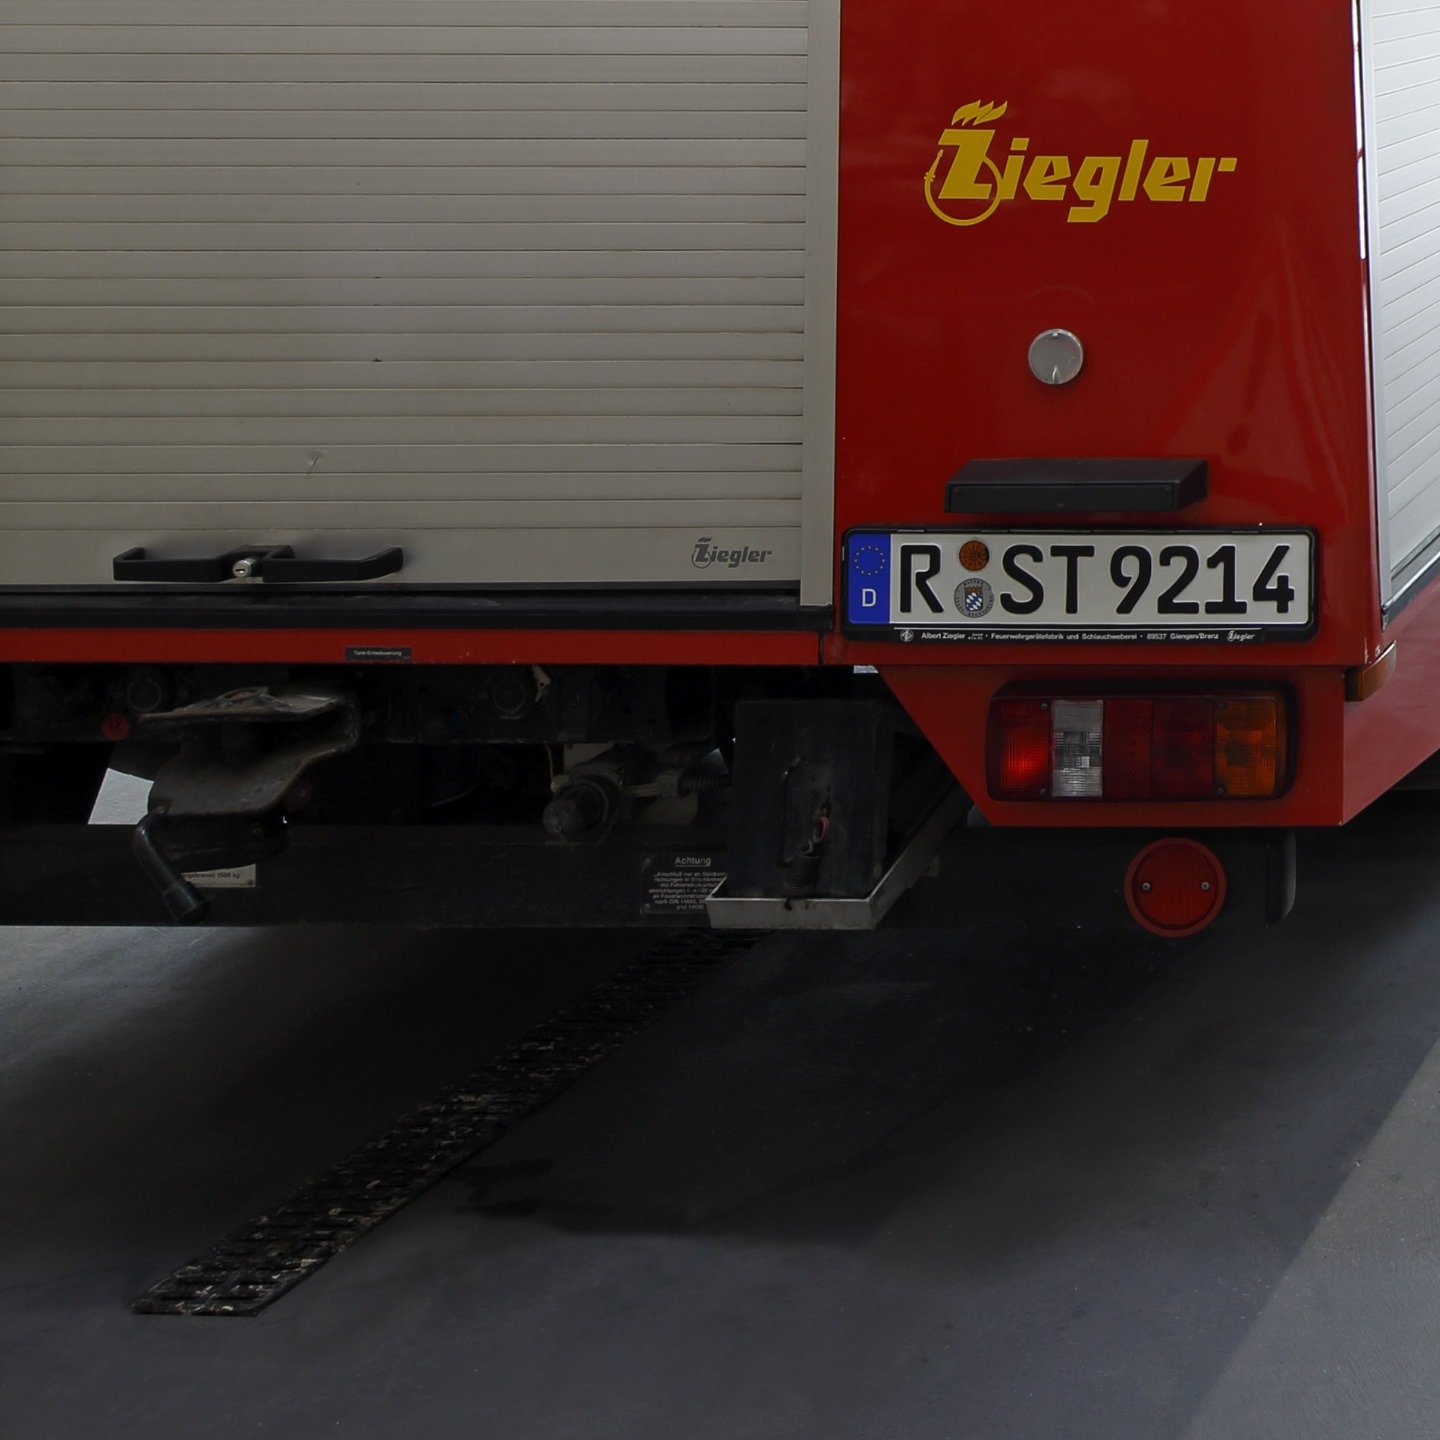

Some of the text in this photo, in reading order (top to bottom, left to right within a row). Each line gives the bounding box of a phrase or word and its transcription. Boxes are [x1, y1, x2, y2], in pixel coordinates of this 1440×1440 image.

[924, 125, 1237, 226] Ziegler
[691, 540, 772, 569] Ziegler
[899, 544, 1295, 615] R ST 9214
[861, 588, 877, 607] D
[675, 857, 711, 867] Achtung
